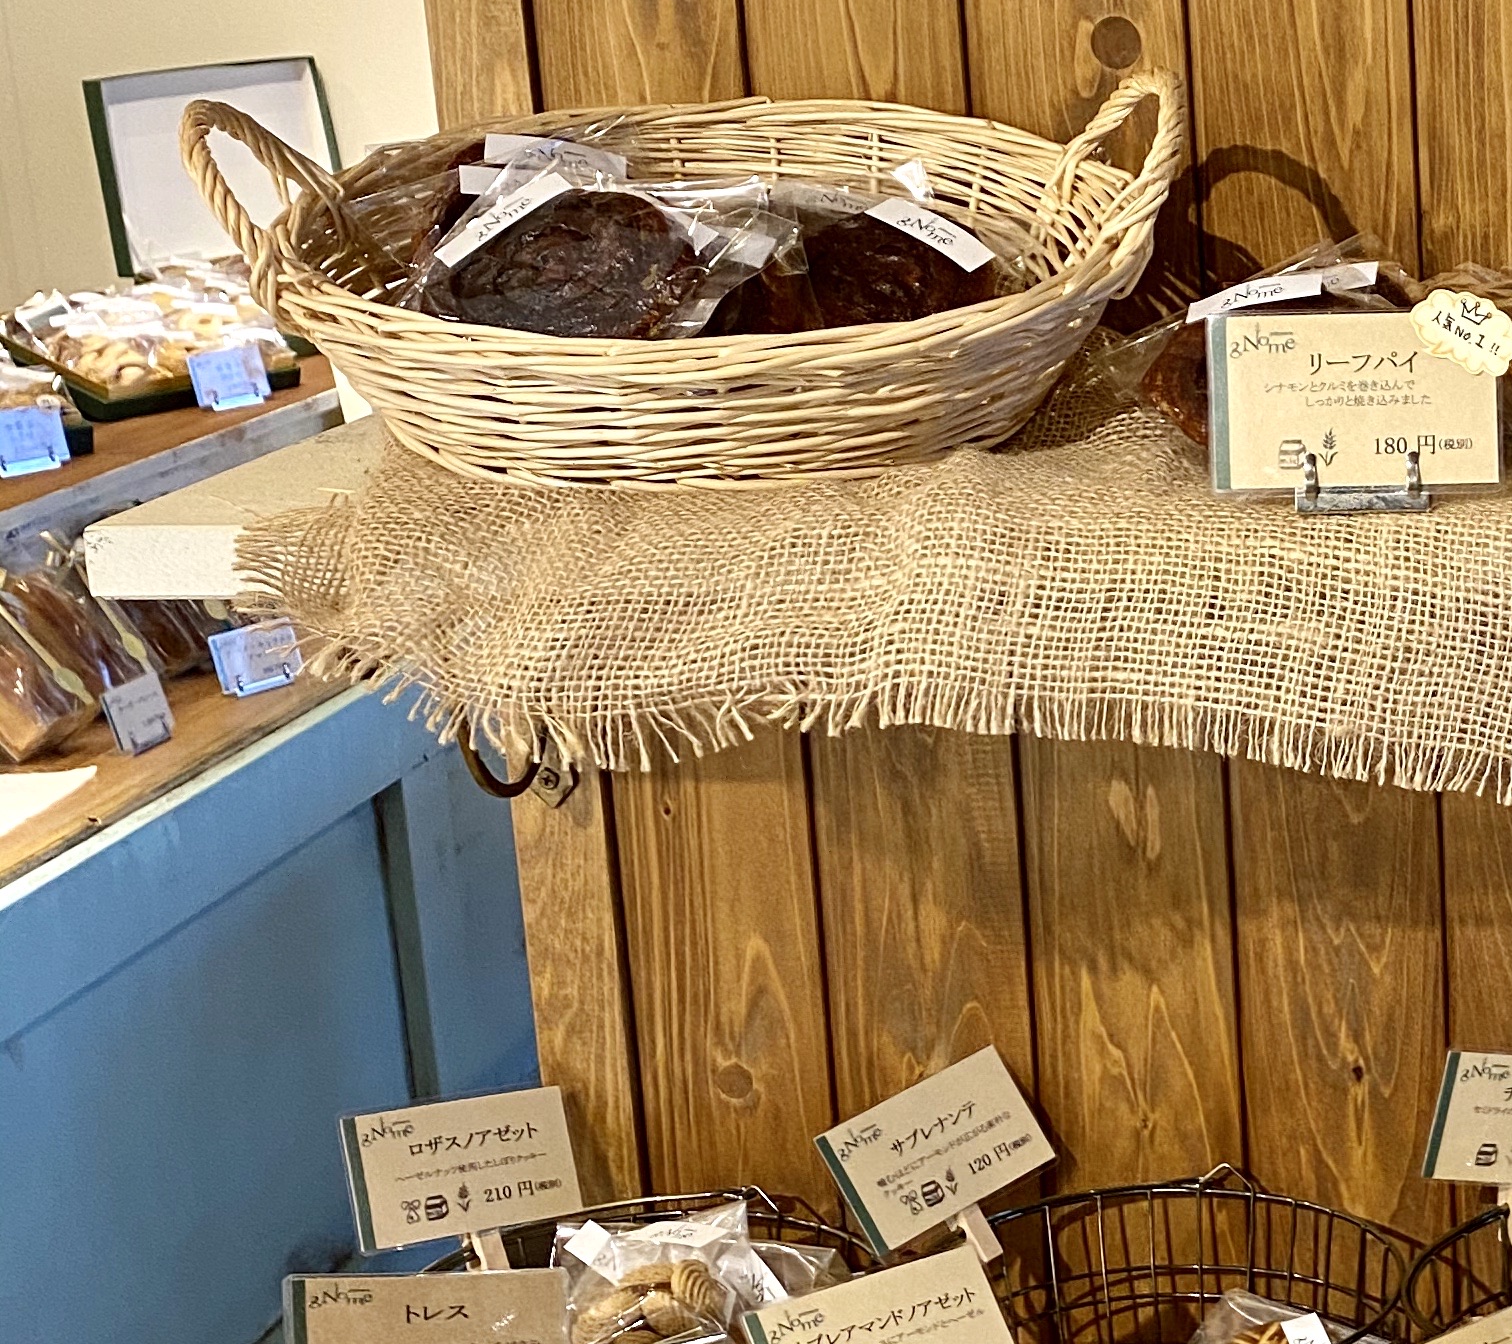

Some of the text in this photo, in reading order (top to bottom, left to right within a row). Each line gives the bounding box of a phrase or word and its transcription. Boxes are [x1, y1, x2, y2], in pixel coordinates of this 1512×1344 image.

[1308, 351, 1420, 375] リーフパイ
[1264, 380, 1415, 393] シナモンとクルミを巻き込んで
[1306, 394, 1432, 407] しっかりと焼き込みました
[889, 1099, 977, 1157] サブレナンテ
[408, 1122, 538, 1157] ロザスノアゼット
[405, 1304, 469, 1324] トレス
